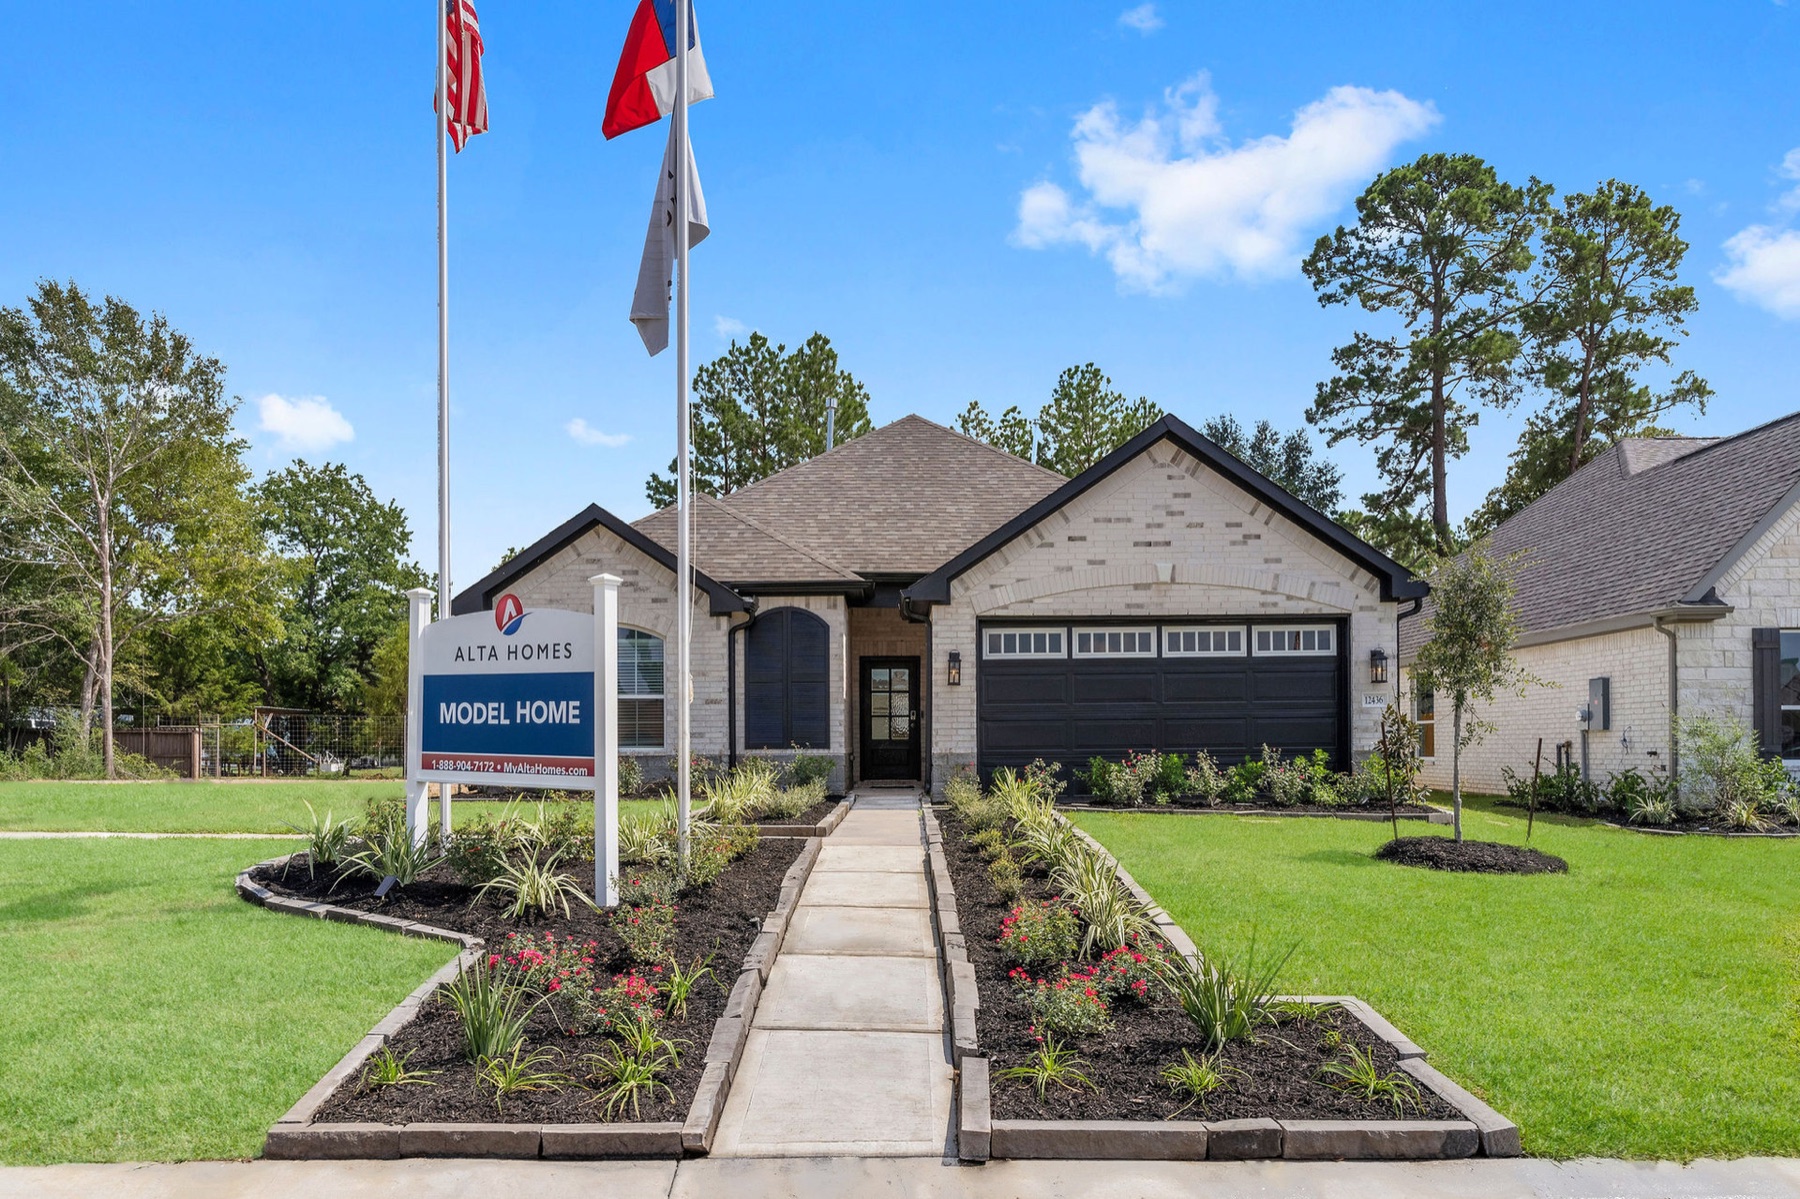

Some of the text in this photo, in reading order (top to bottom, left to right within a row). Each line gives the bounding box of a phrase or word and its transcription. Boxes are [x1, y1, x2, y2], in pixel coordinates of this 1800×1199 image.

[455, 642, 572, 662] ALTA HOMES
[1365, 696, 1383, 704] 12436
[440, 701, 580, 724] MODEL HOME
[432, 760, 588, 776] 1-888-904-7172 MyAltaHomes.com
